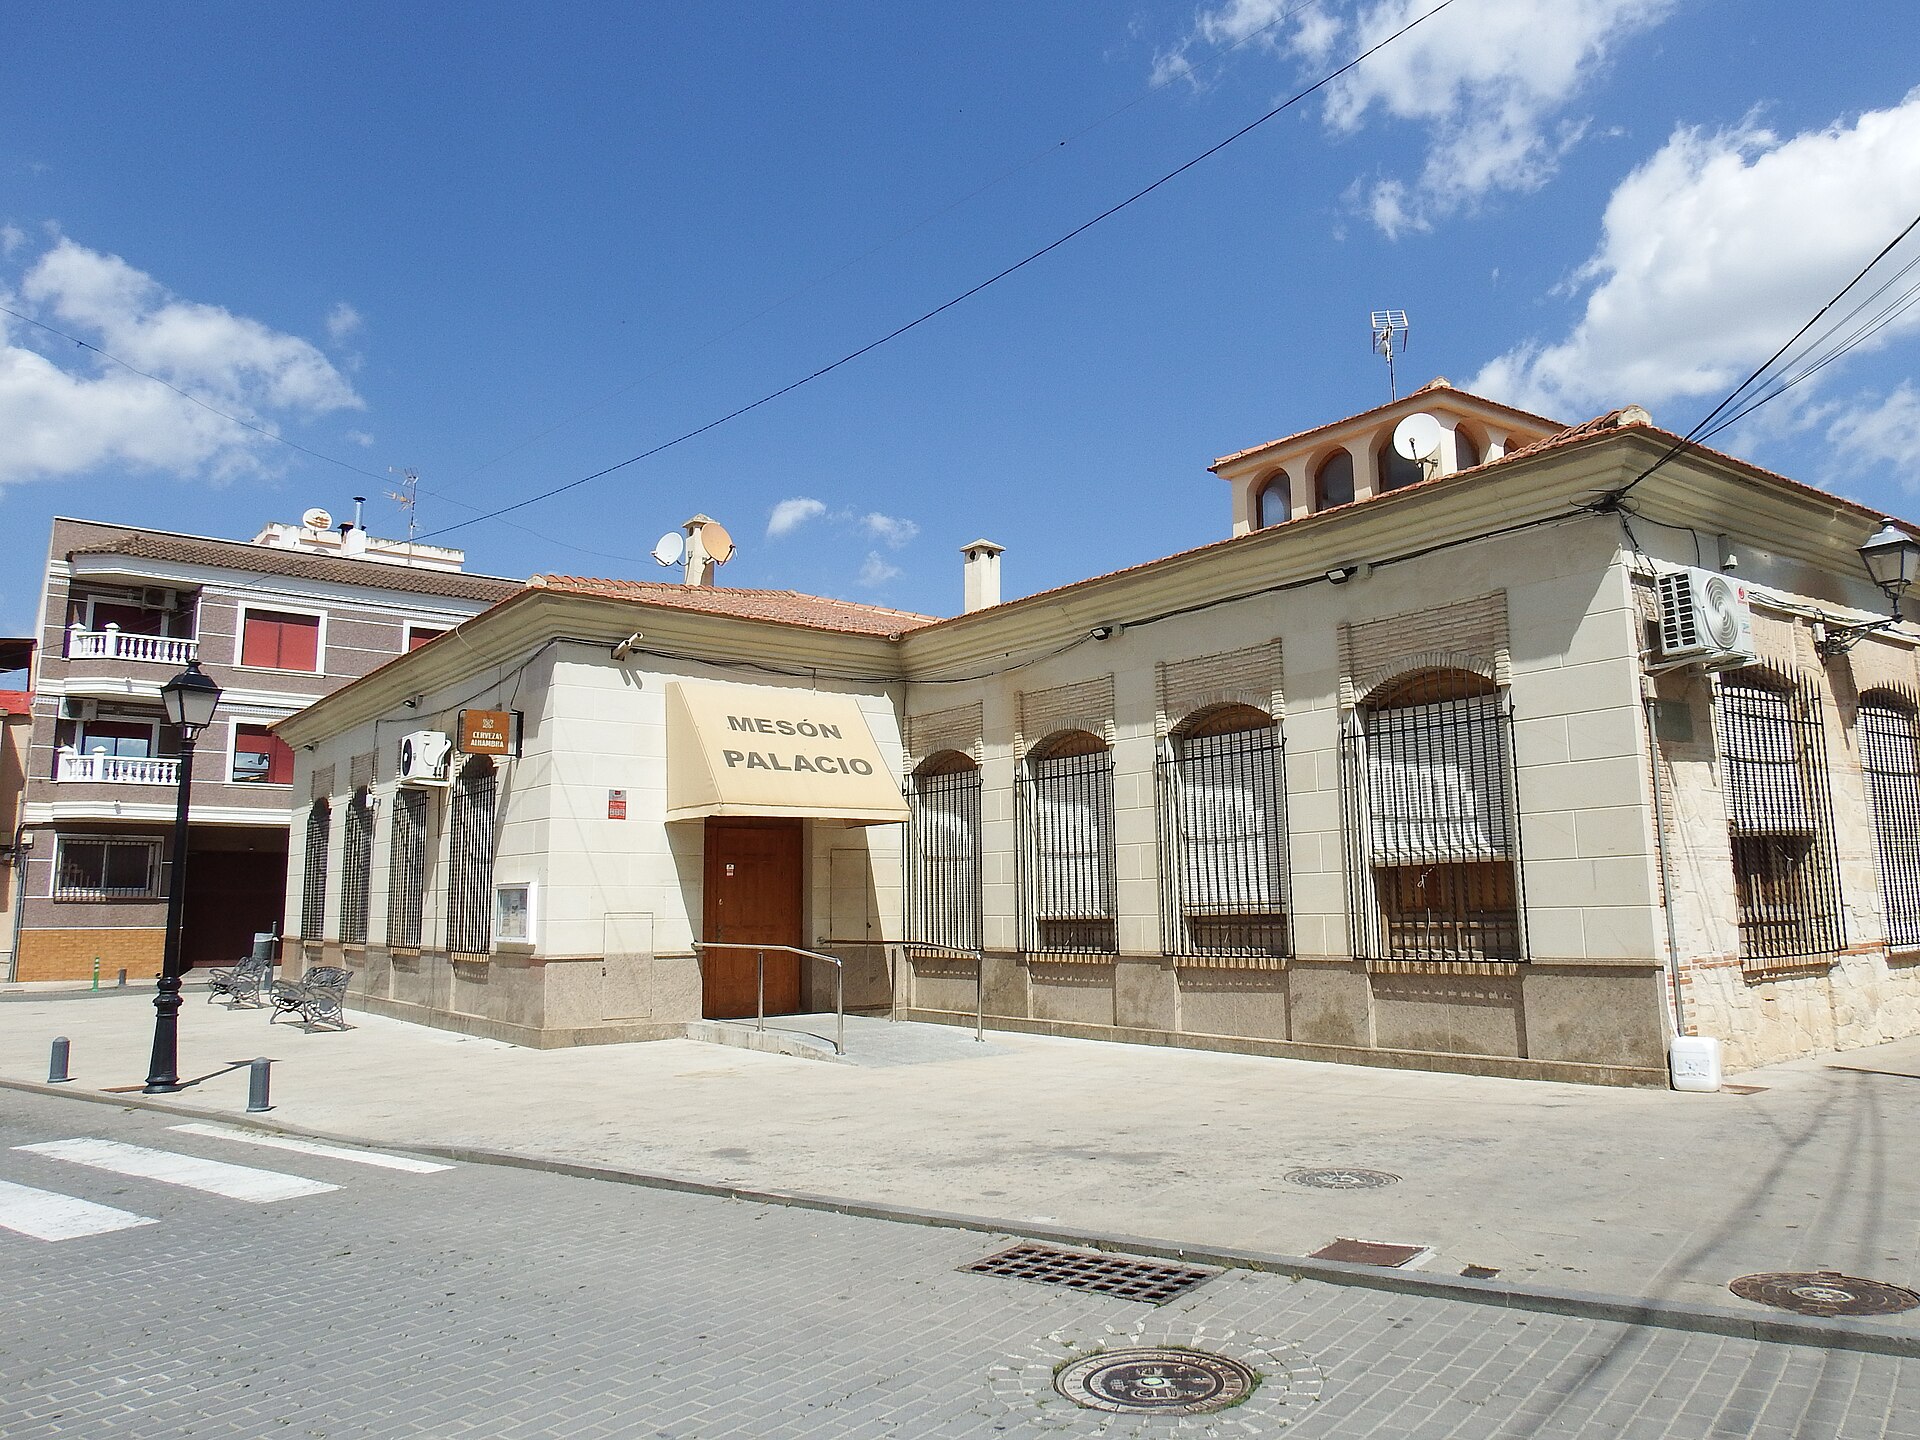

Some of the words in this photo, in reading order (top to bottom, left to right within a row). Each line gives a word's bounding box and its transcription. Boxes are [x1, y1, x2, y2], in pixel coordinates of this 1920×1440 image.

[472, 731, 503, 740] CERVEZAS
[727, 716, 842, 739] MESÓN
[470, 739, 504, 748] ALHAMBRA
[723, 749, 873, 776] PALACIO
